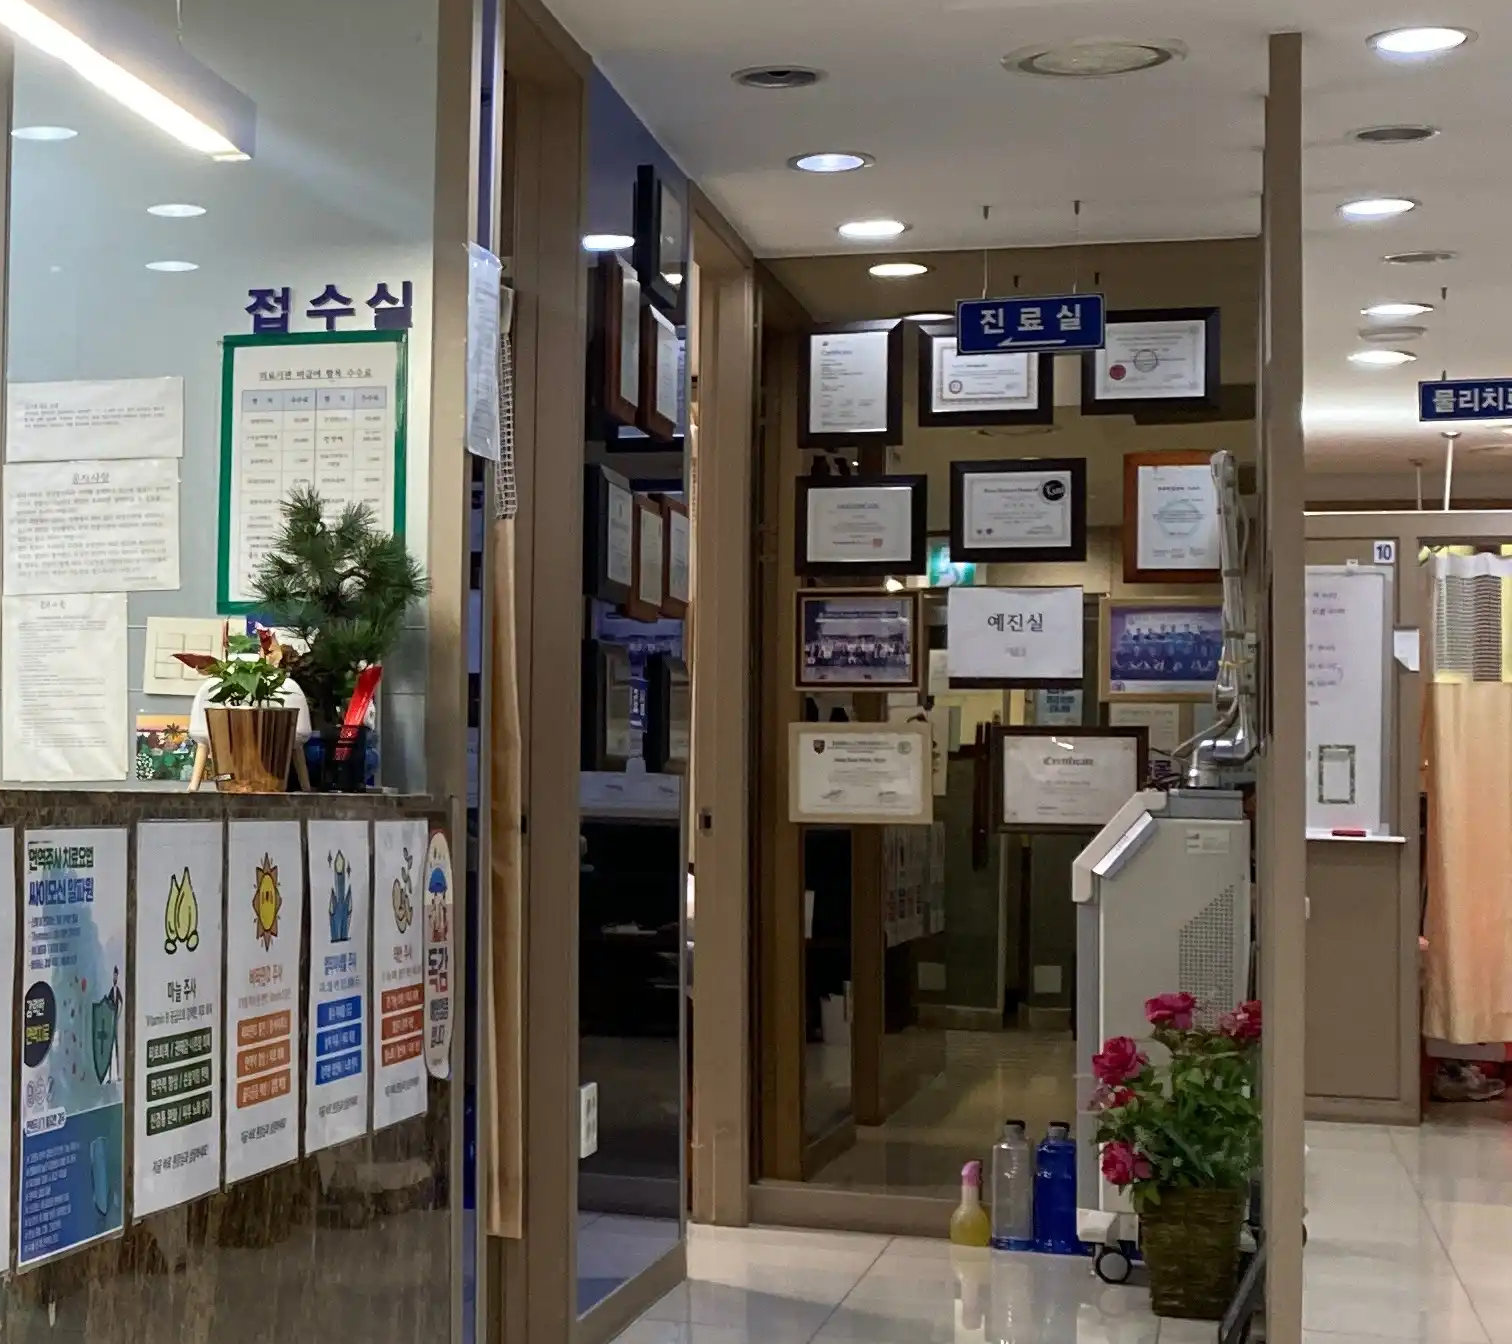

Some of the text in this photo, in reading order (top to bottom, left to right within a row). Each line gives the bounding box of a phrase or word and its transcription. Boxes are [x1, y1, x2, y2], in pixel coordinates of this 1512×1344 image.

[246, 280, 413, 333] 접수실
[979, 306, 1083, 335] 진료실
[1376, 543, 1393, 561] 10
[987, 613, 1043, 632] 예진실
[28, 879, 67, 907] 싸이모신
